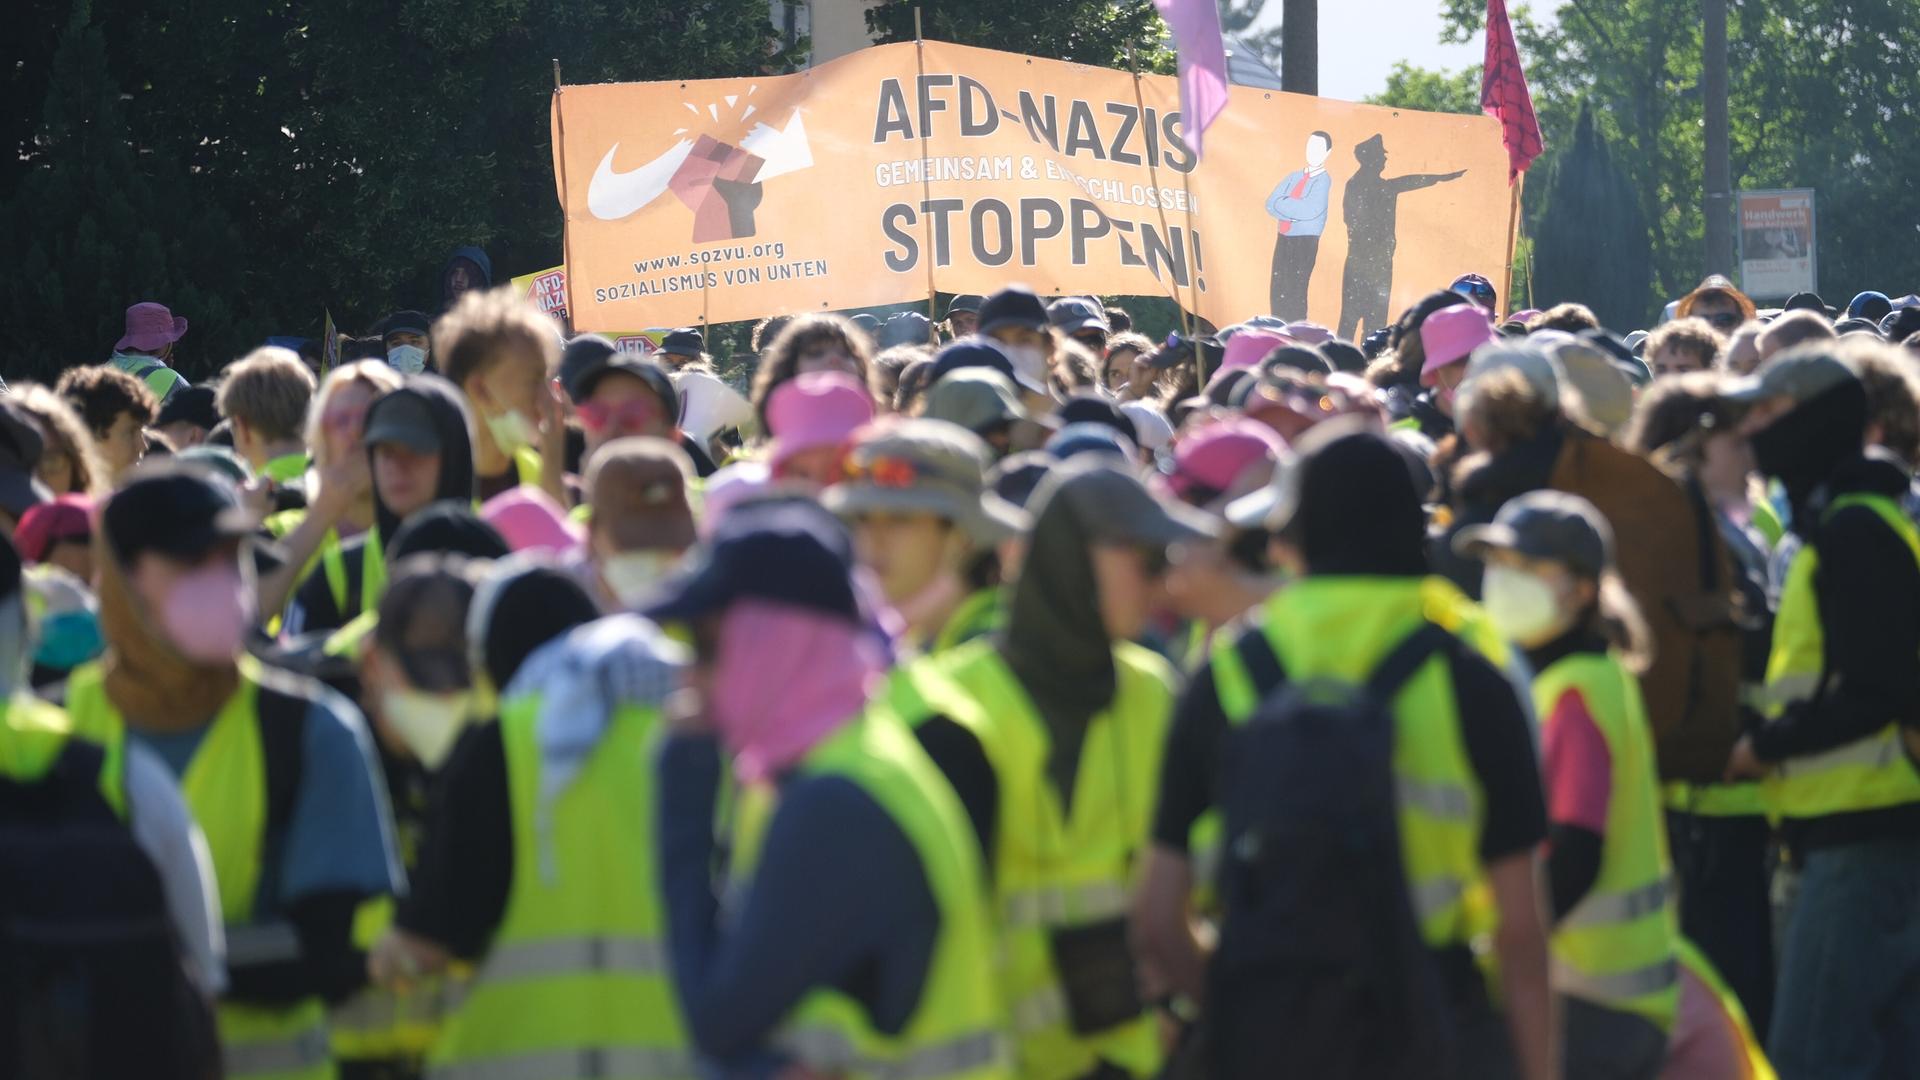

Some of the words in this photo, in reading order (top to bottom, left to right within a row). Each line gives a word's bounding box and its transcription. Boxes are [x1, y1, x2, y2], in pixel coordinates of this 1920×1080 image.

[873, 74, 1198, 173] AFD-NAZIS
[875, 155, 1013, 188] GEMEINSAM
[1020, 155, 1039, 180] &
[634, 242, 784, 274] www.sozvu.org
[881, 197, 1206, 293] STOPPEN!
[595, 271, 717, 303] SOZIALISMUS
[724, 266, 760, 286] VON
[767, 258, 828, 281] UNTEN
